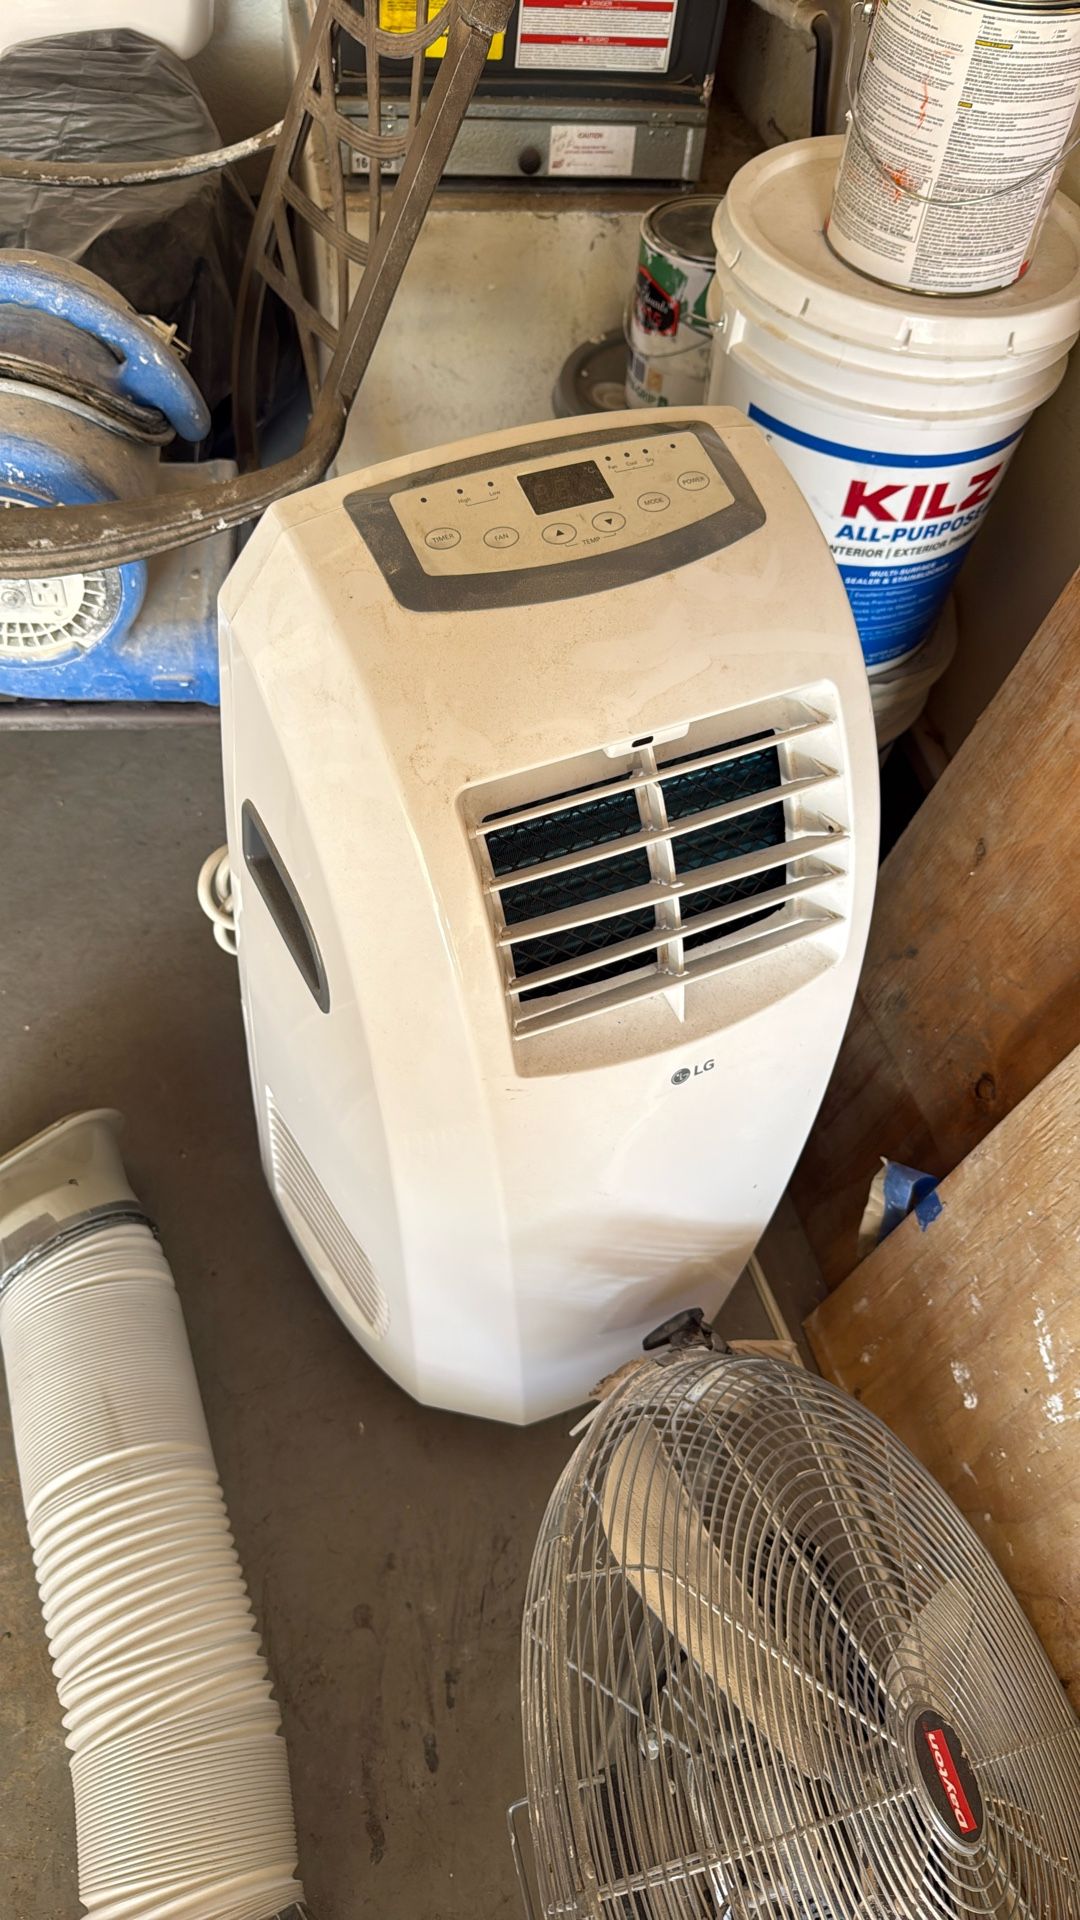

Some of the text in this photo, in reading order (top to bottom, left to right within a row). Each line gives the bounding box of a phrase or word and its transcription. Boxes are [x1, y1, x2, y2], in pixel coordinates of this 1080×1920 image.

[682, 476, 705, 486] POWER
[841, 462, 1003, 522] KILZ
[458, 497, 472, 505] High
[643, 497, 665, 506] MODE
[835, 503, 987, 543] ALL-PURPOSE
[432, 533, 455, 544] TIMER
[494, 532, 509, 542] FAN
[582, 536, 601, 546] TEMP
[829, 545, 883, 559] NTERIOR
[893, 540, 947, 557] EXTERIOR
[845, 577, 880, 585] SEALER
[881, 577, 889, 585] &
[694, 1059, 715, 1076] LG
[928, 1733, 969, 1829] Dayton
